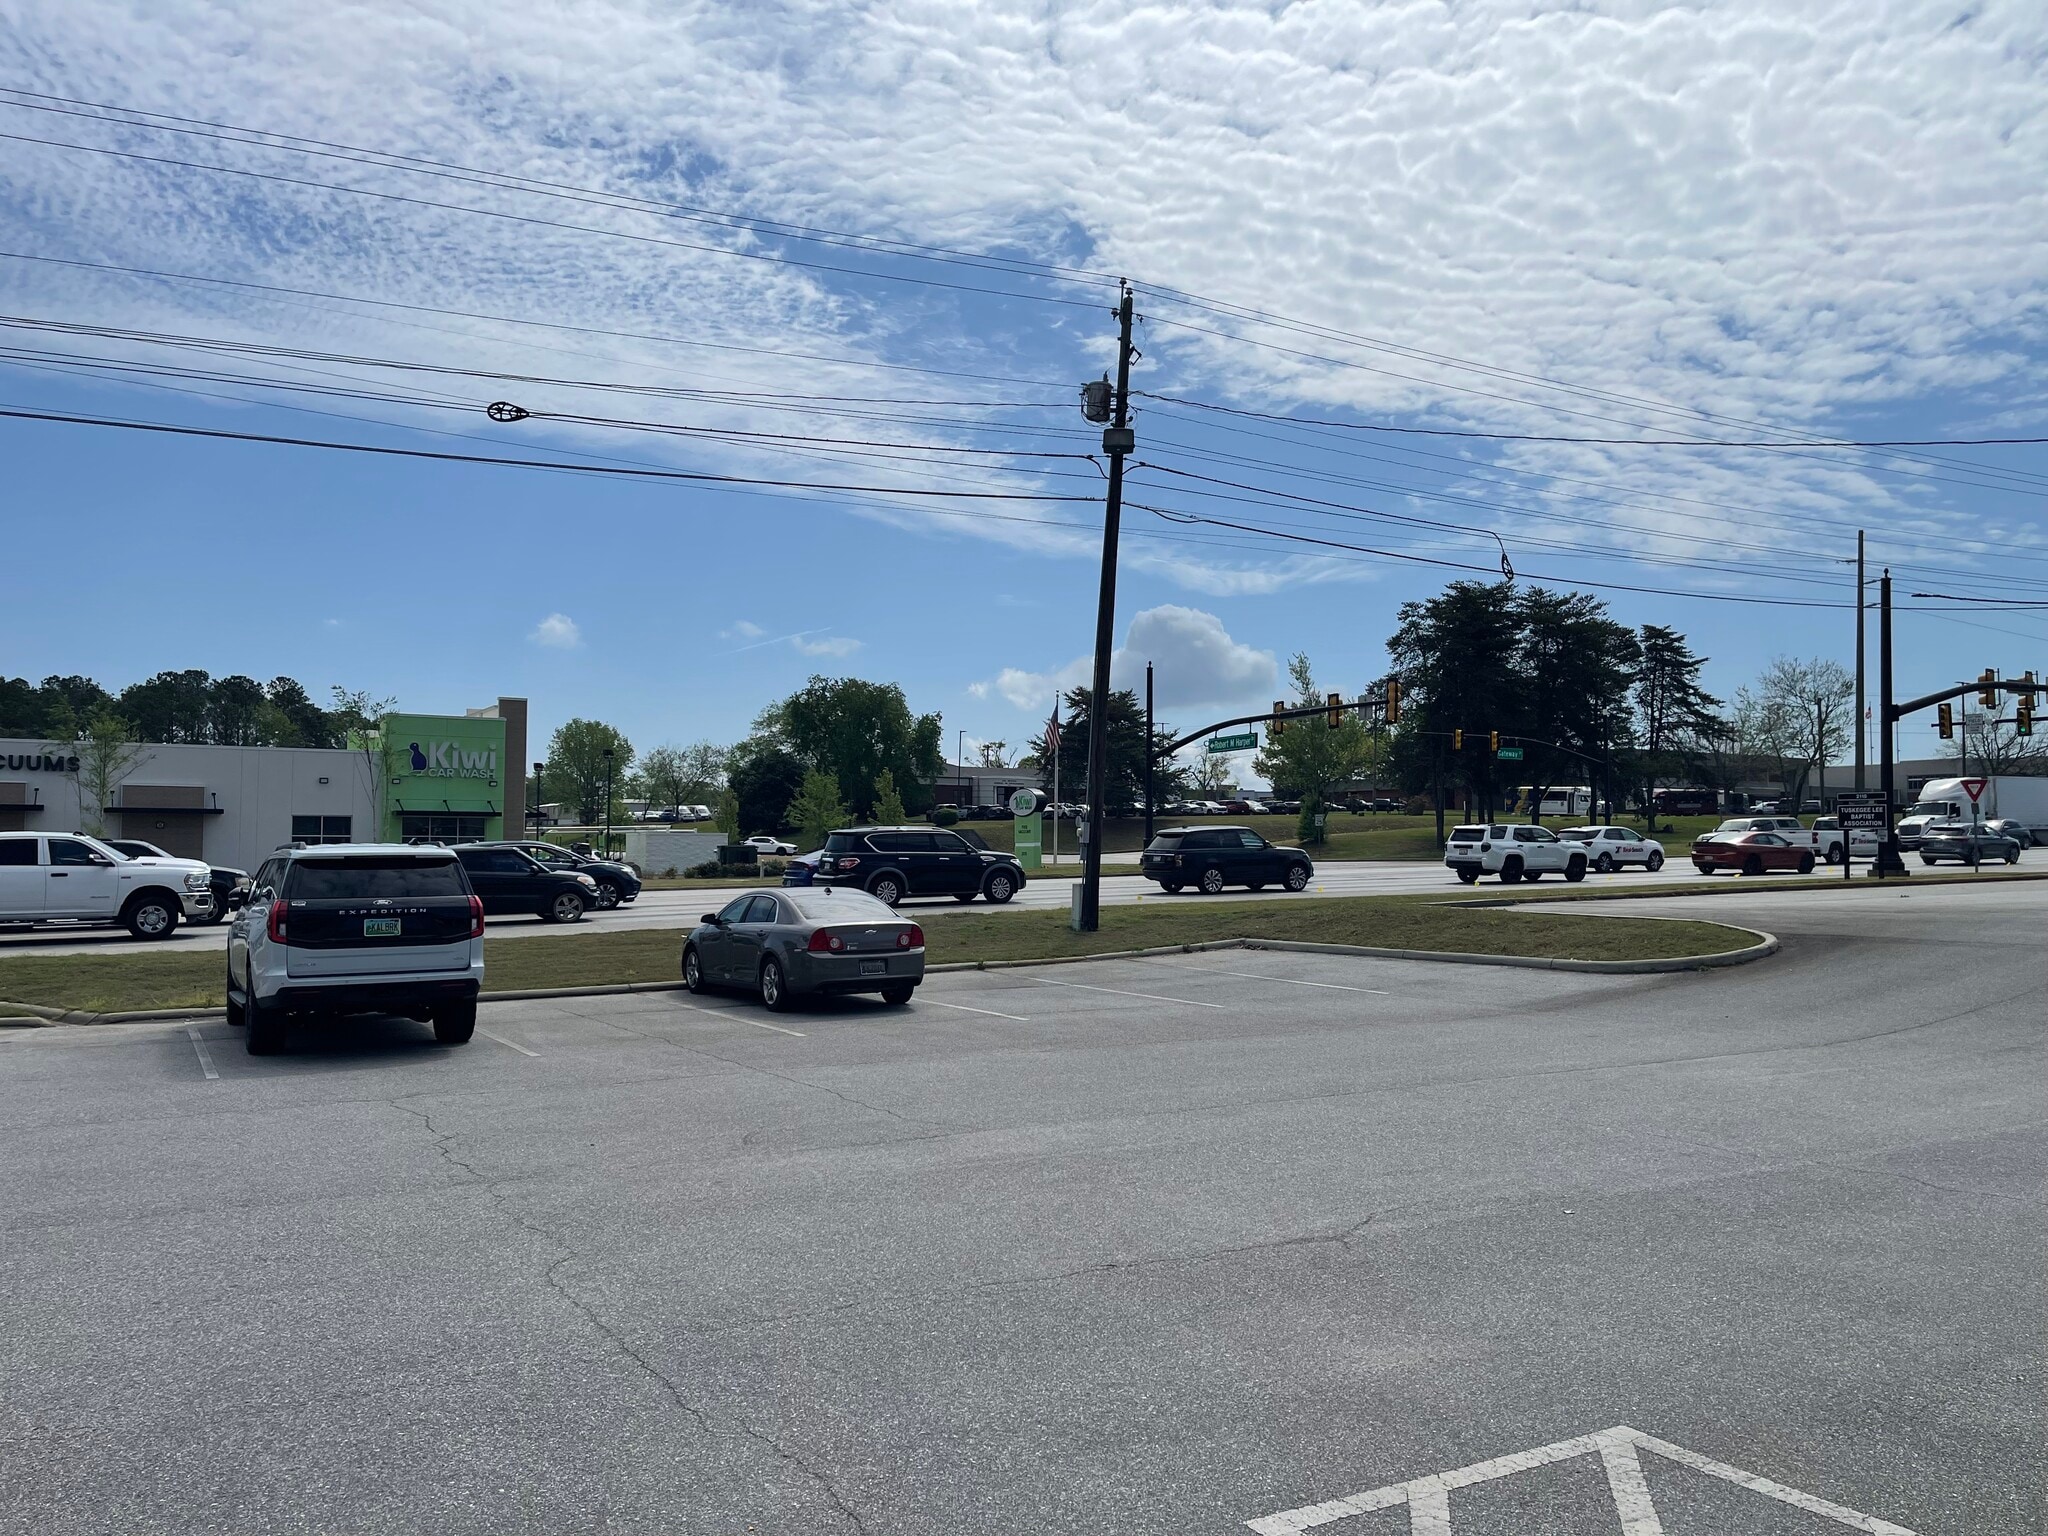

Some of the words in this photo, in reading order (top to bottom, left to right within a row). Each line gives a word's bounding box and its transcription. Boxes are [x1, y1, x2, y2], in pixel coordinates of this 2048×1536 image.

[1214, 740, 1229, 750] Robert
[1236, 737, 1251, 748] Harper
[428, 741, 496, 770] Kiwi
[428, 768, 455, 778] CAR
[460, 769, 496, 779] WASH
